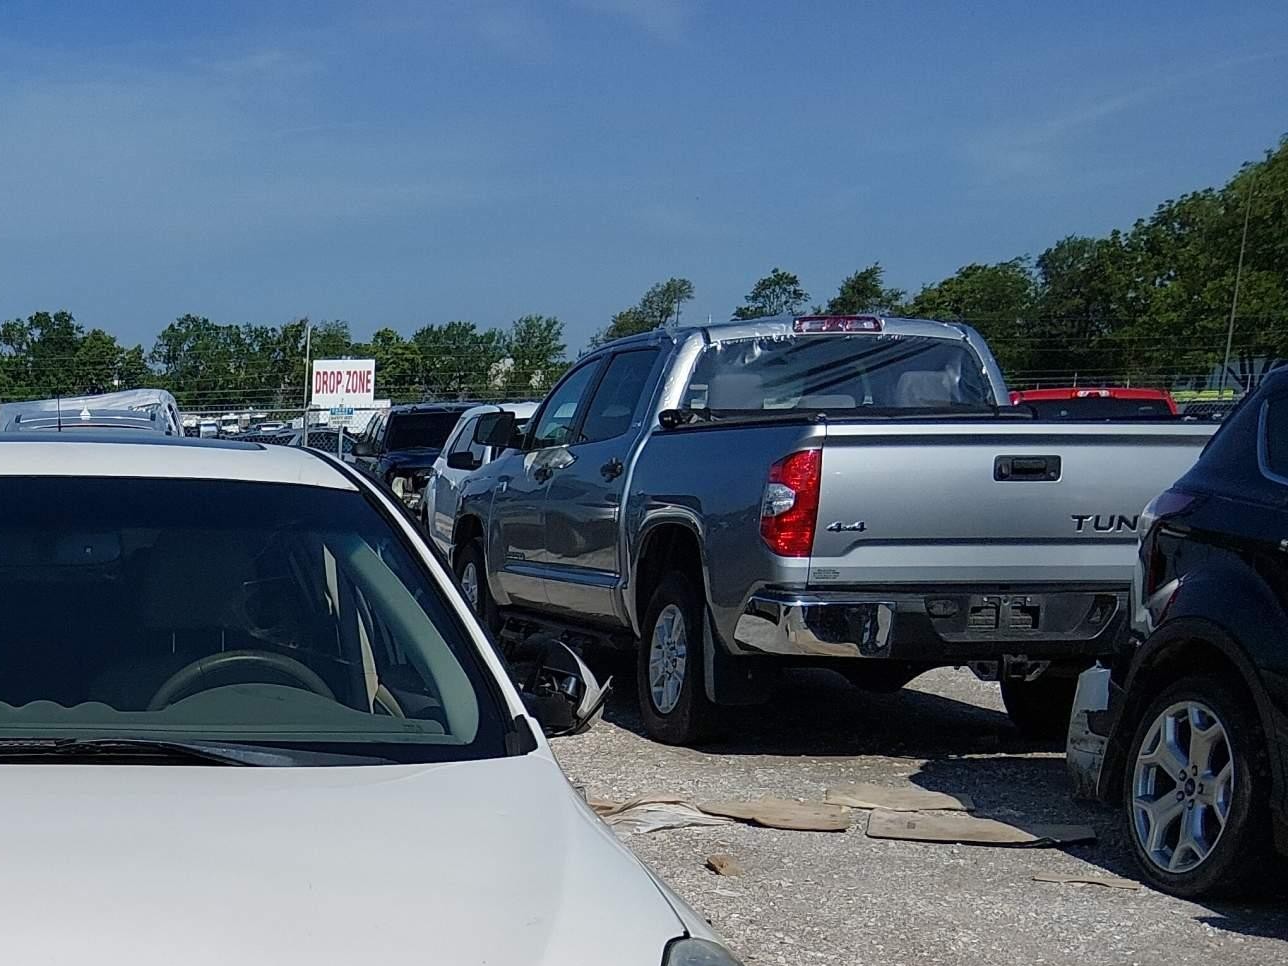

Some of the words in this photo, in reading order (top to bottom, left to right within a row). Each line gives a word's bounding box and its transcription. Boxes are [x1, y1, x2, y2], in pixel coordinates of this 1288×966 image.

[315, 370, 343, 394] DROP
[345, 370, 372, 393] ZONE
[1071, 514, 1140, 533] TUN
